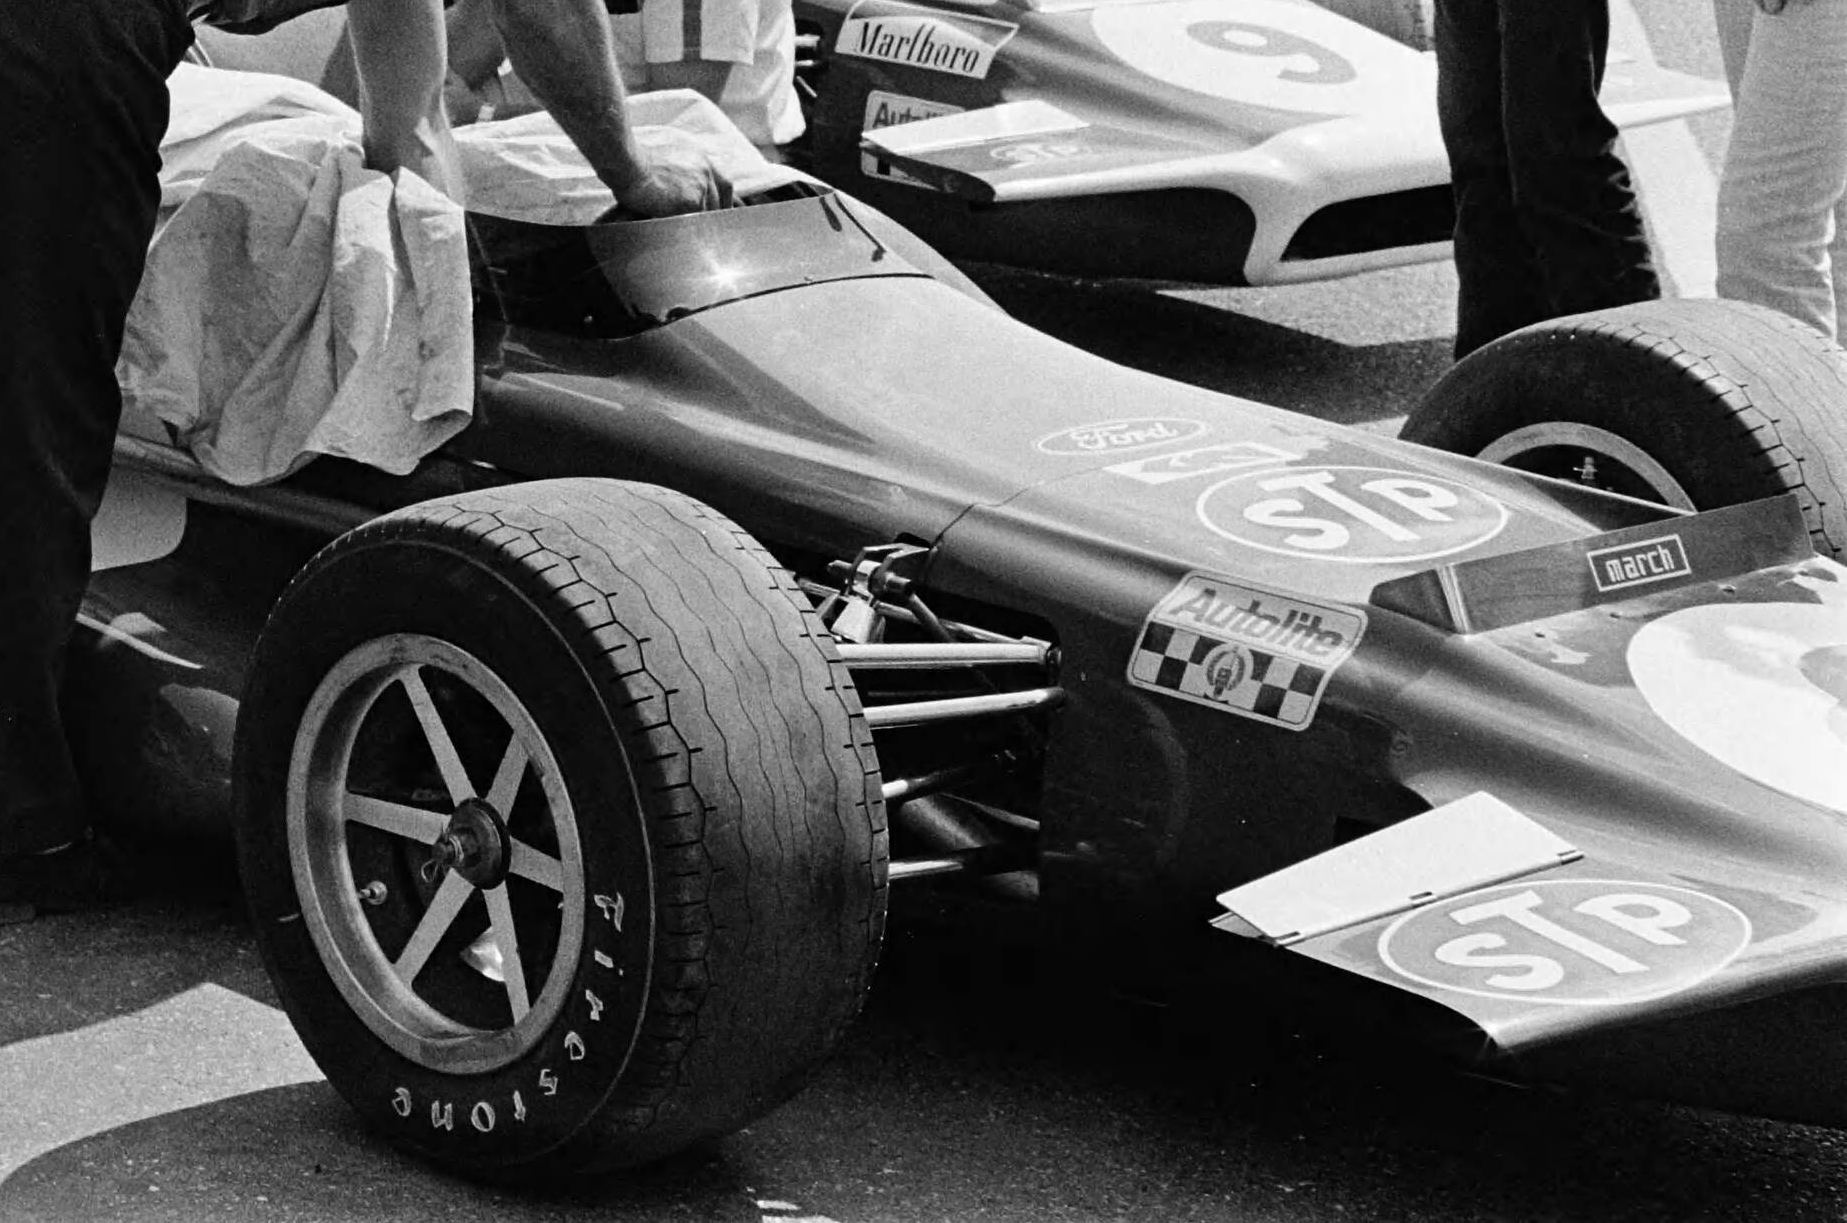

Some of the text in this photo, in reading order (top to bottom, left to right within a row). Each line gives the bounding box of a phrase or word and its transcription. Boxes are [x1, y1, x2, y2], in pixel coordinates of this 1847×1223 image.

[857, 21, 981, 74] Marlboro
[1068, 421, 1179, 450] Ford
[1242, 470, 1460, 551] STP
[1605, 544, 1676, 584] march
[1168, 587, 1344, 657] Autolite
[1434, 888, 1693, 992] STP
